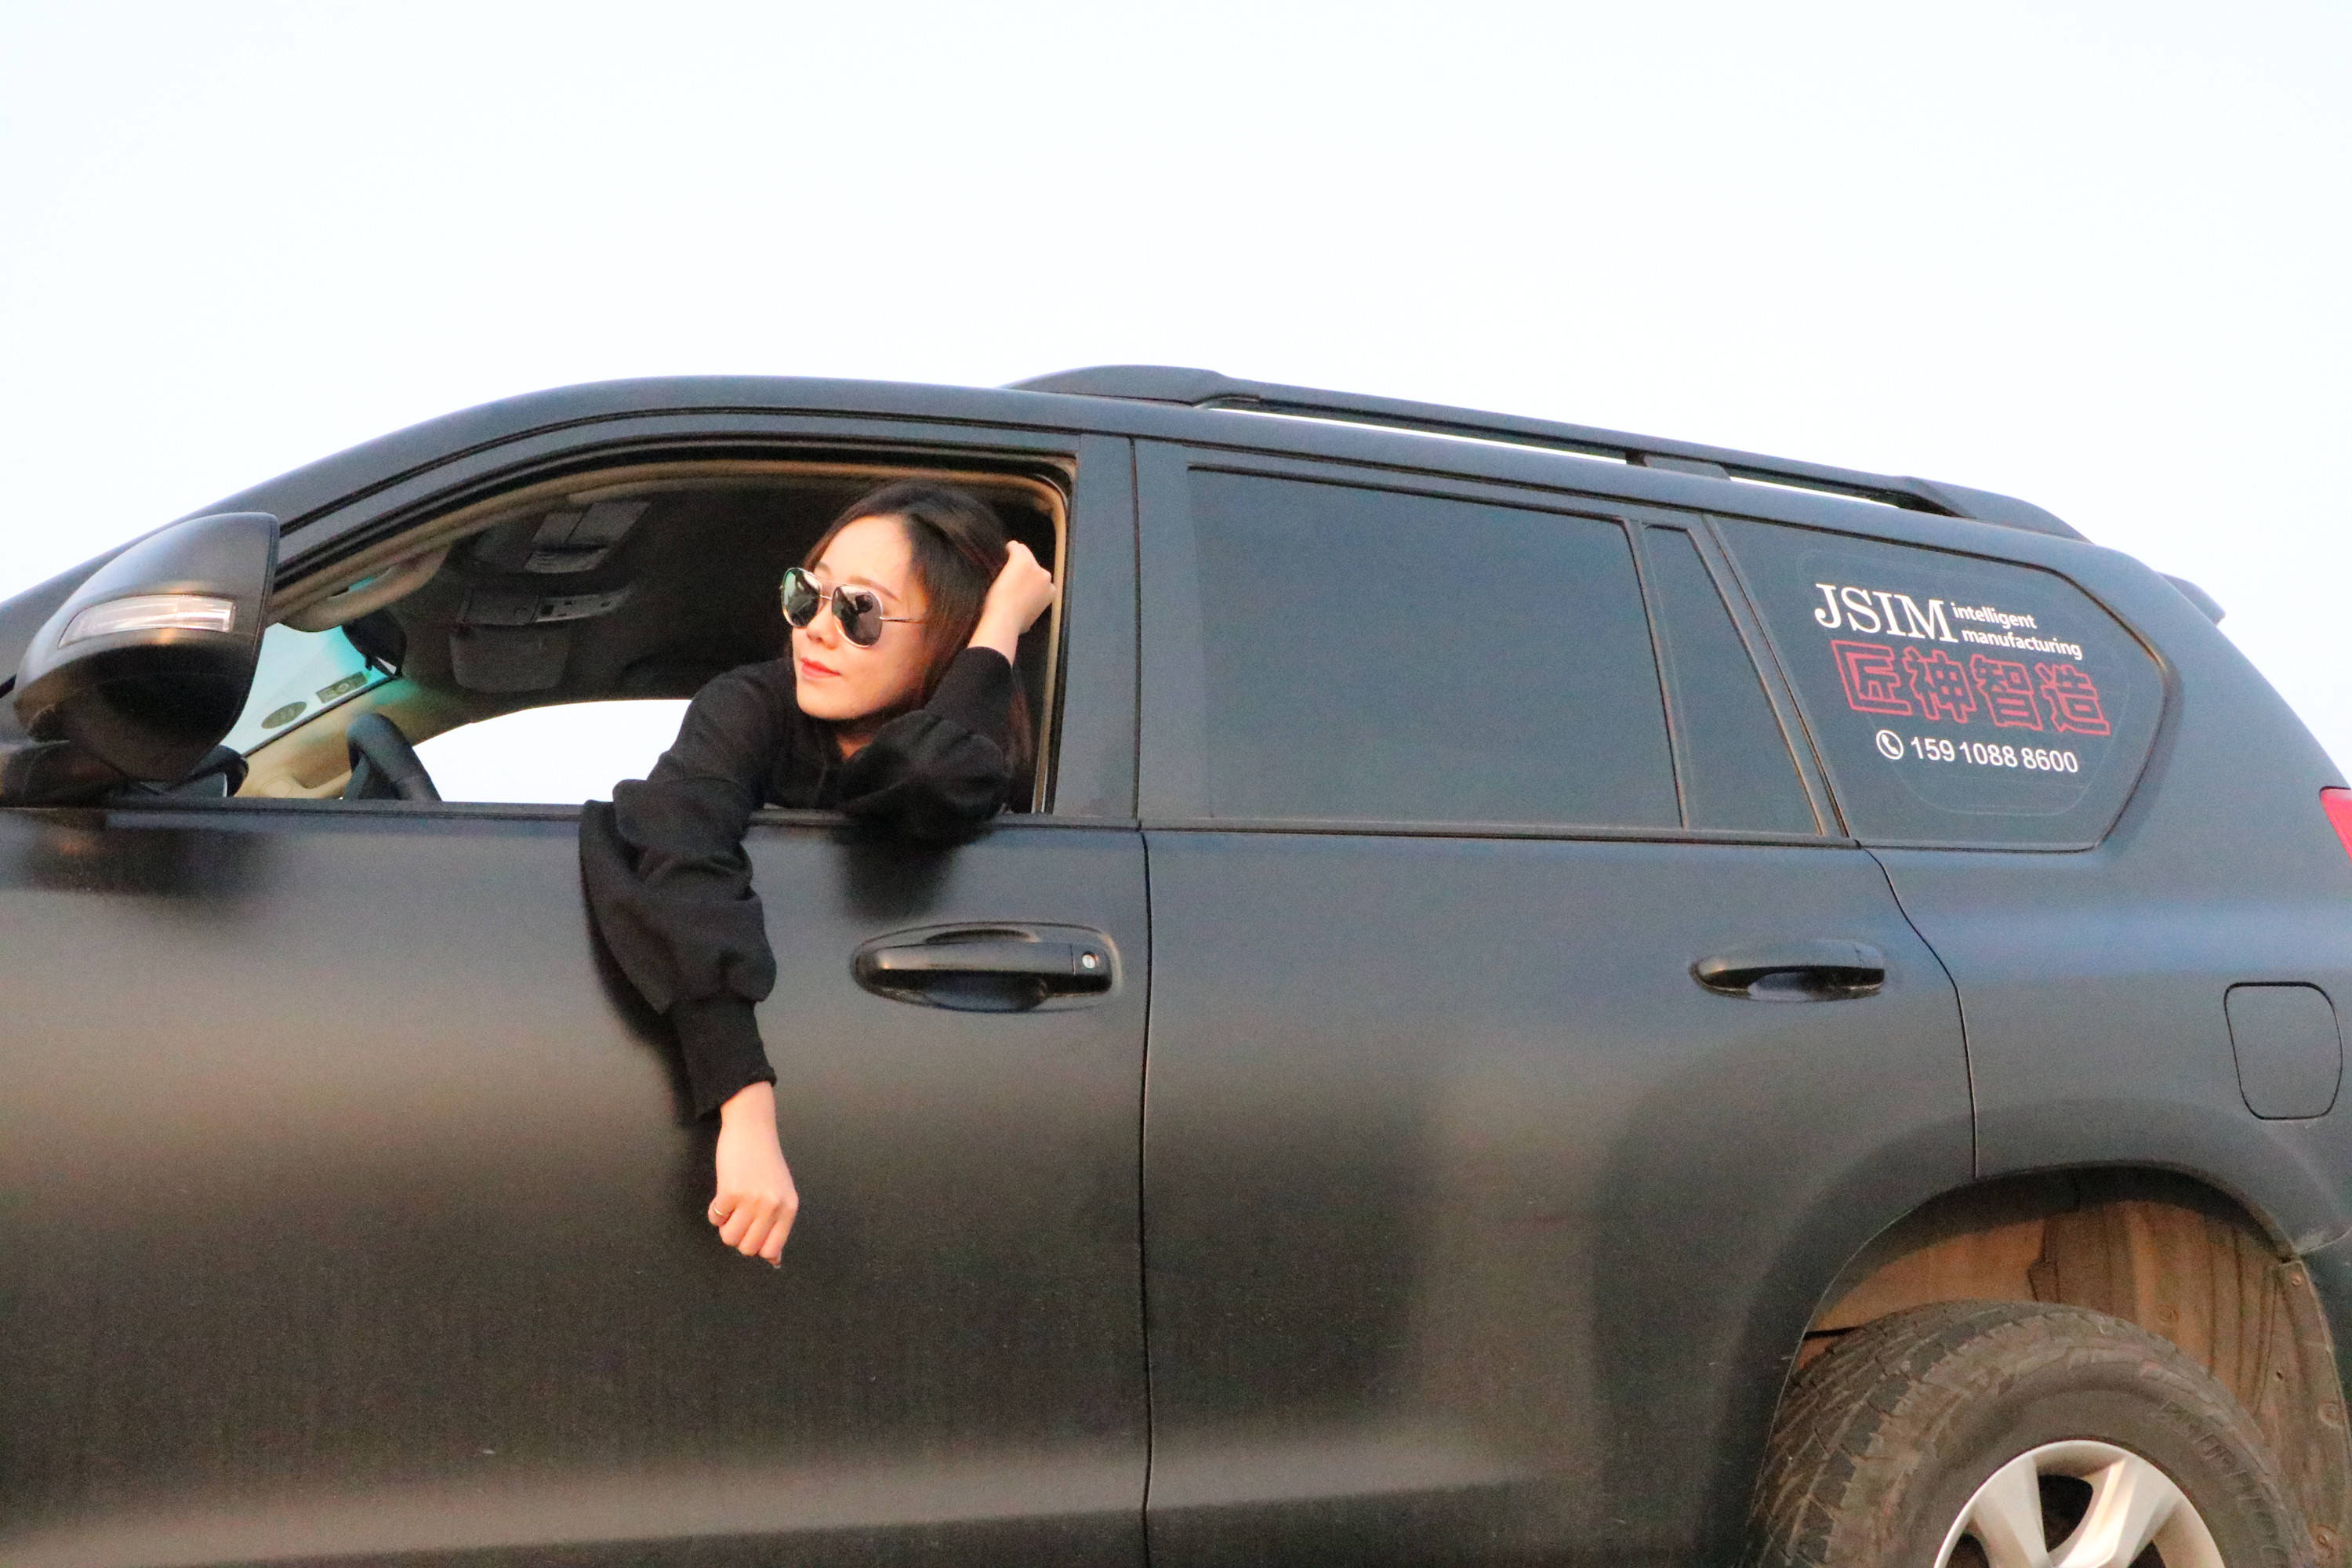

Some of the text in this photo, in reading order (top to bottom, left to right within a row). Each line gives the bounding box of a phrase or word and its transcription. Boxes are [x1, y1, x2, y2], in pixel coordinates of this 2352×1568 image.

[1813, 583, 1958, 644] JSIM
[1951, 601, 2037, 630] intelligent
[1961, 627, 2083, 661] manufacturing
[1831, 639, 2111, 736] 匠神智造
[1910, 736, 2079, 773] 159 1088 8600
